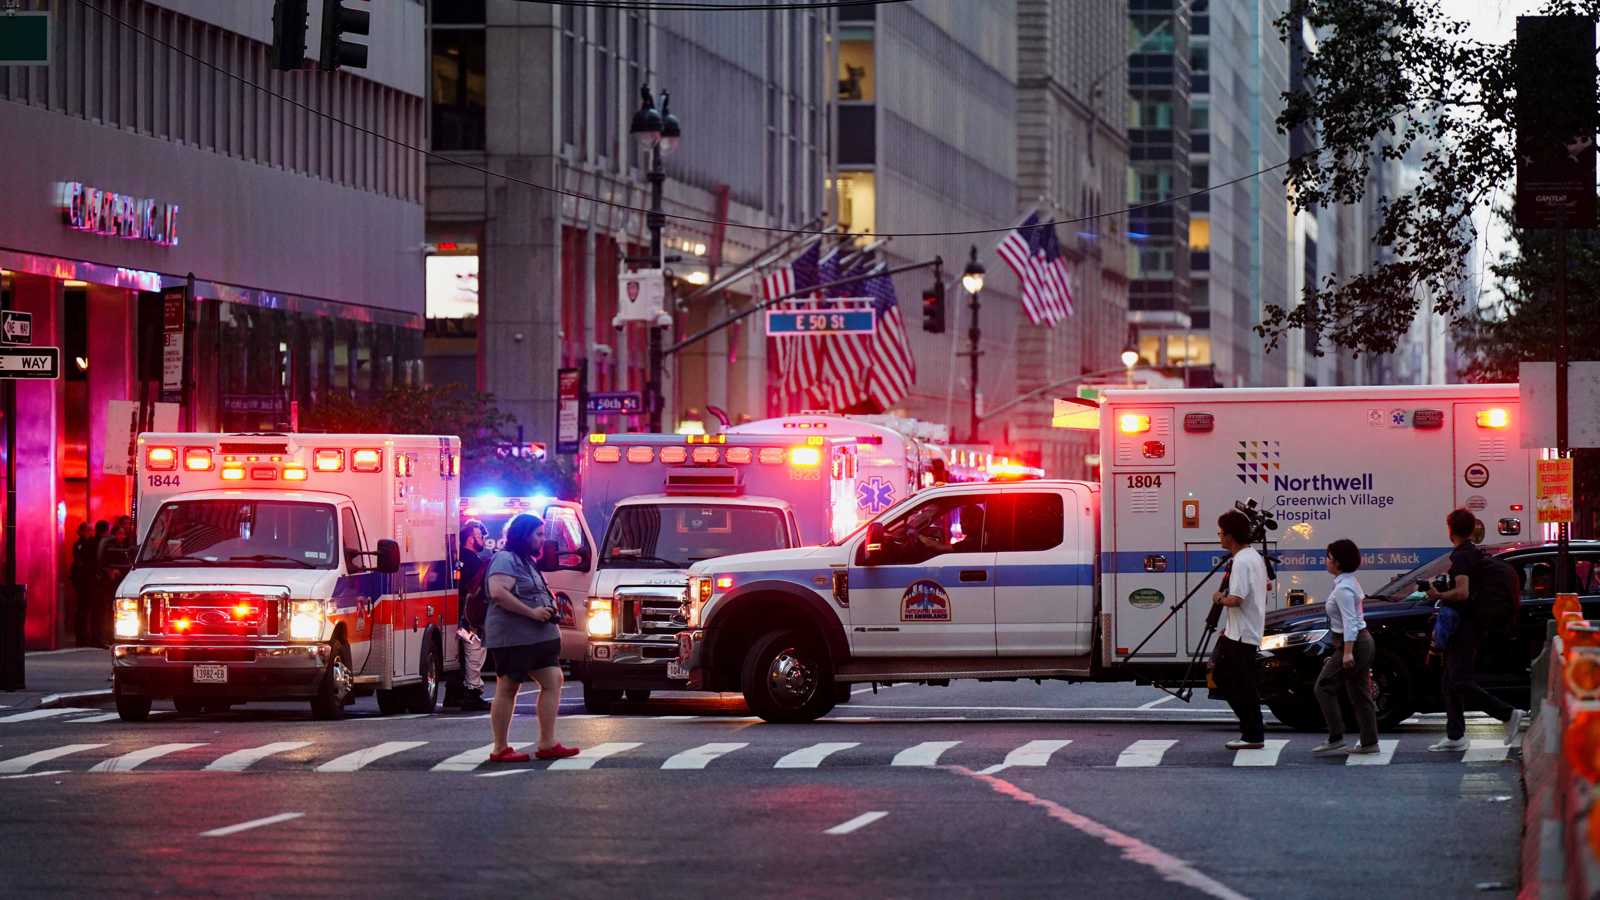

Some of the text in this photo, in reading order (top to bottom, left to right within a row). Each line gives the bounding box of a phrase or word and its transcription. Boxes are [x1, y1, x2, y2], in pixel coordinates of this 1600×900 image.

[796, 314, 845, 329] E 50 St
[21, 357, 48, 369] WAY
[147, 474, 181, 487] 1844
[1127, 475, 1163, 489] 1804
[1274, 473, 1373, 491] Northwell
[1276, 493, 1395, 508] Greenwich Village
[1276, 508, 1331, 523] Hospital
[1278, 553, 1317, 566] Sondra
[1377, 553, 1387, 564] S.
[1390, 552, 1420, 564] Mack
